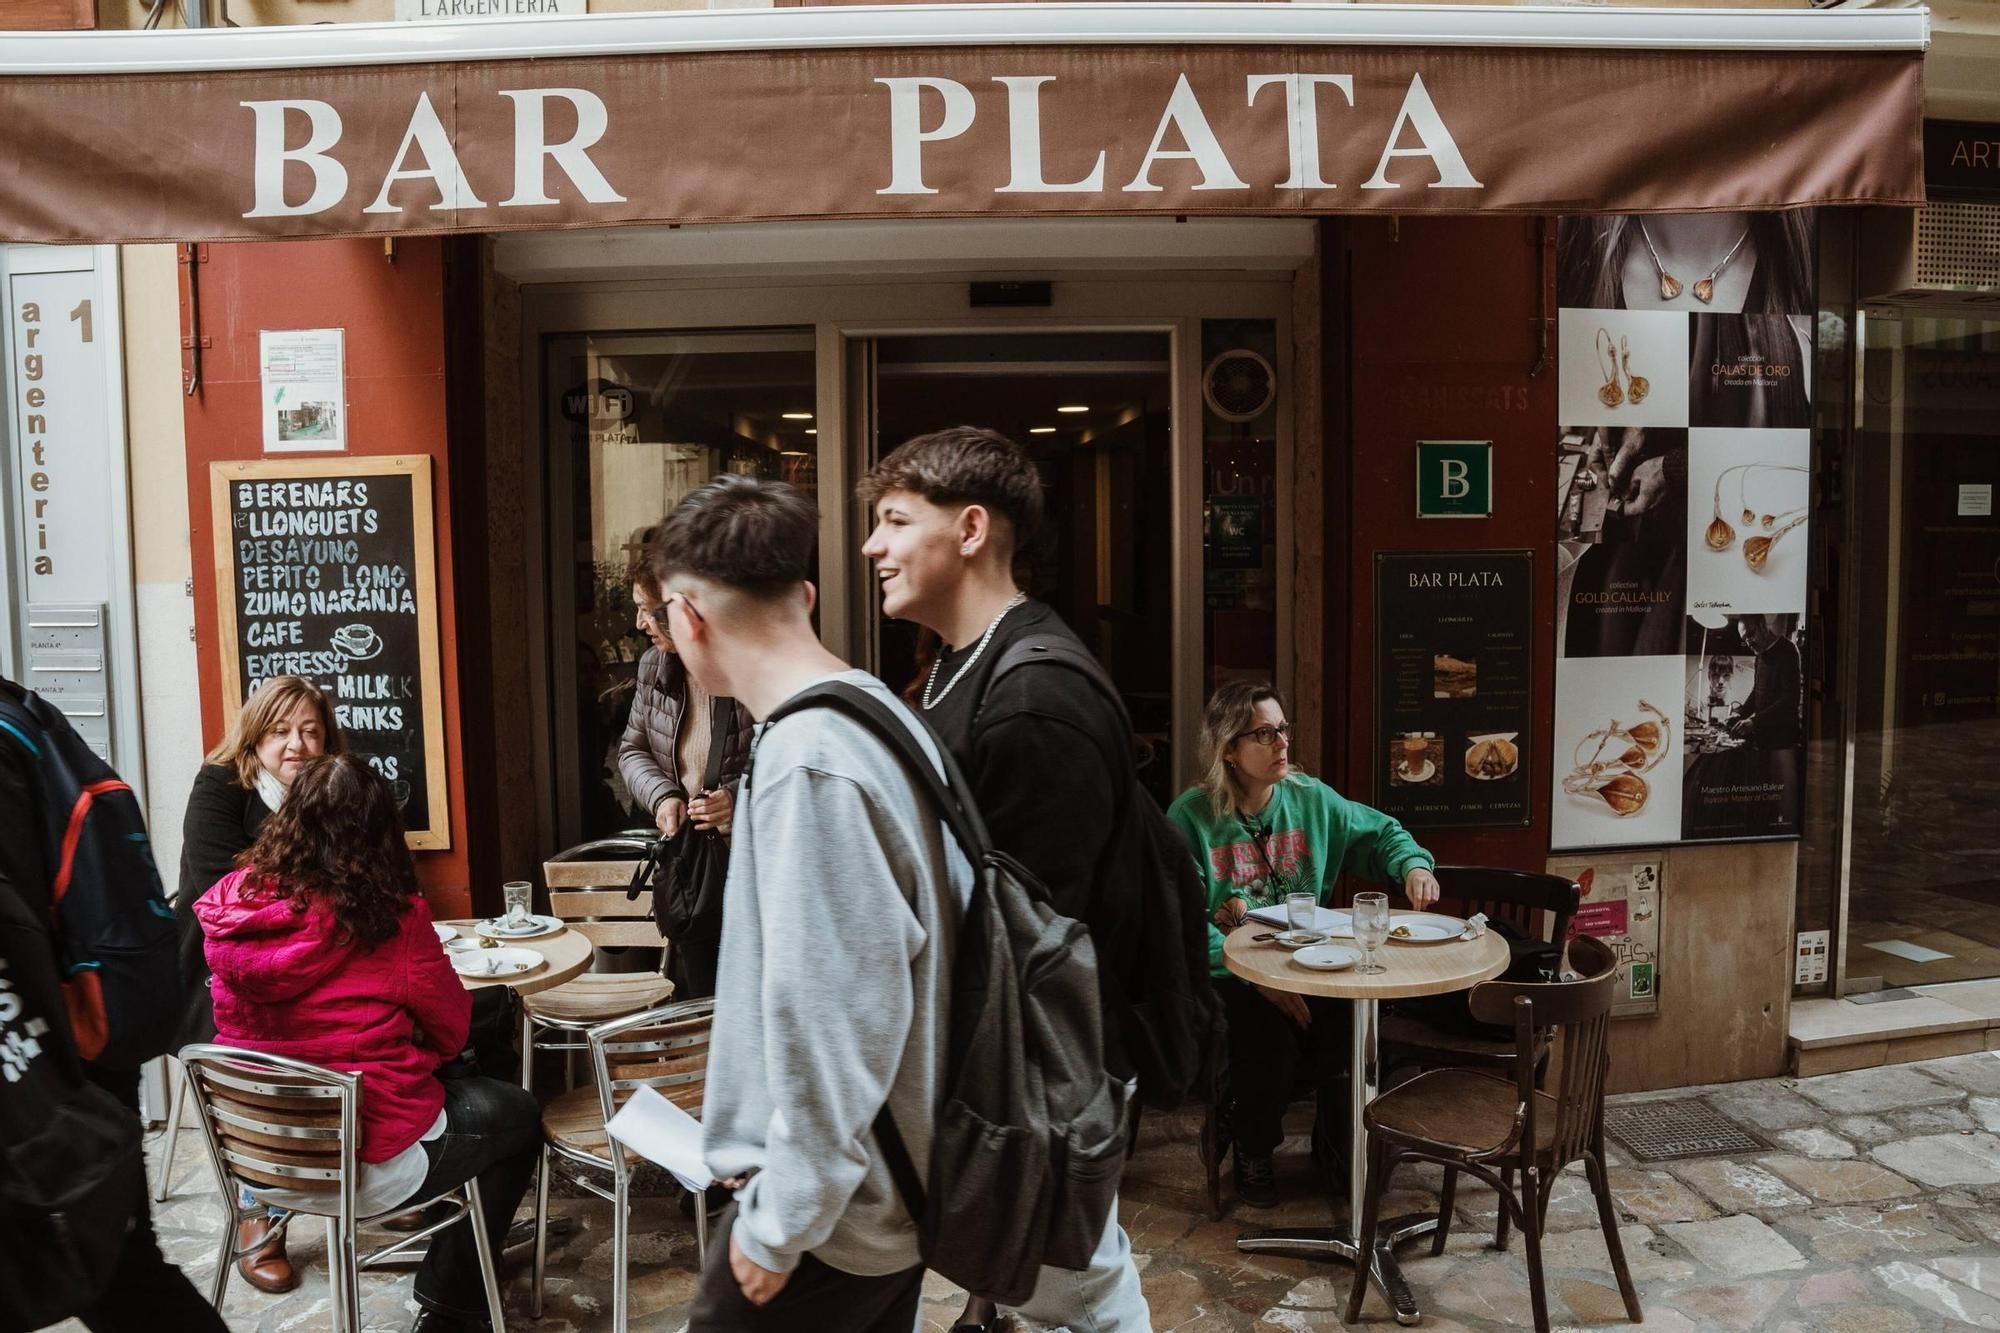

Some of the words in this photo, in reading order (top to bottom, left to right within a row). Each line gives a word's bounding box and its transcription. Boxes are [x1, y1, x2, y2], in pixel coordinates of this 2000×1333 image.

[422, 0, 559, 16] LARGENTERIA
[240, 88, 627, 218] BAR
[874, 71, 1484, 194] PLATA
[70, 300, 93, 343] 1
[1711, 364, 1746, 375] CALAS
[1749, 365, 1763, 376] DE
[1765, 365, 1791, 377] ORO
[21, 302, 53, 575] argenteria
[1440, 459, 1470, 498] B
[238, 481, 368, 509] BERENARS
[249, 508, 378, 538] LLONGUETS
[1229, 527, 1245, 536] WC
[239, 538, 359, 564] DESAYUNO
[243, 565, 321, 590] PEPITO
[342, 565, 406, 589] LOMO
[1409, 573, 1443, 587] BAR
[1449, 572, 1503, 587] PLATA
[244, 591, 307, 617] ZUMO
[310, 588, 416, 615] NARANJA
[1575, 592, 1609, 604] GOLD
[246, 621, 303, 647] CAFE
[246, 651, 349, 678] EXPRESSO
[338, 674, 391, 700] MILK
[335, 706, 403, 731] RINKS
[1701, 786, 1730, 794] Maestro
[1731, 785, 1762, 793] Artesano
[1763, 783, 1785, 792] Balear
